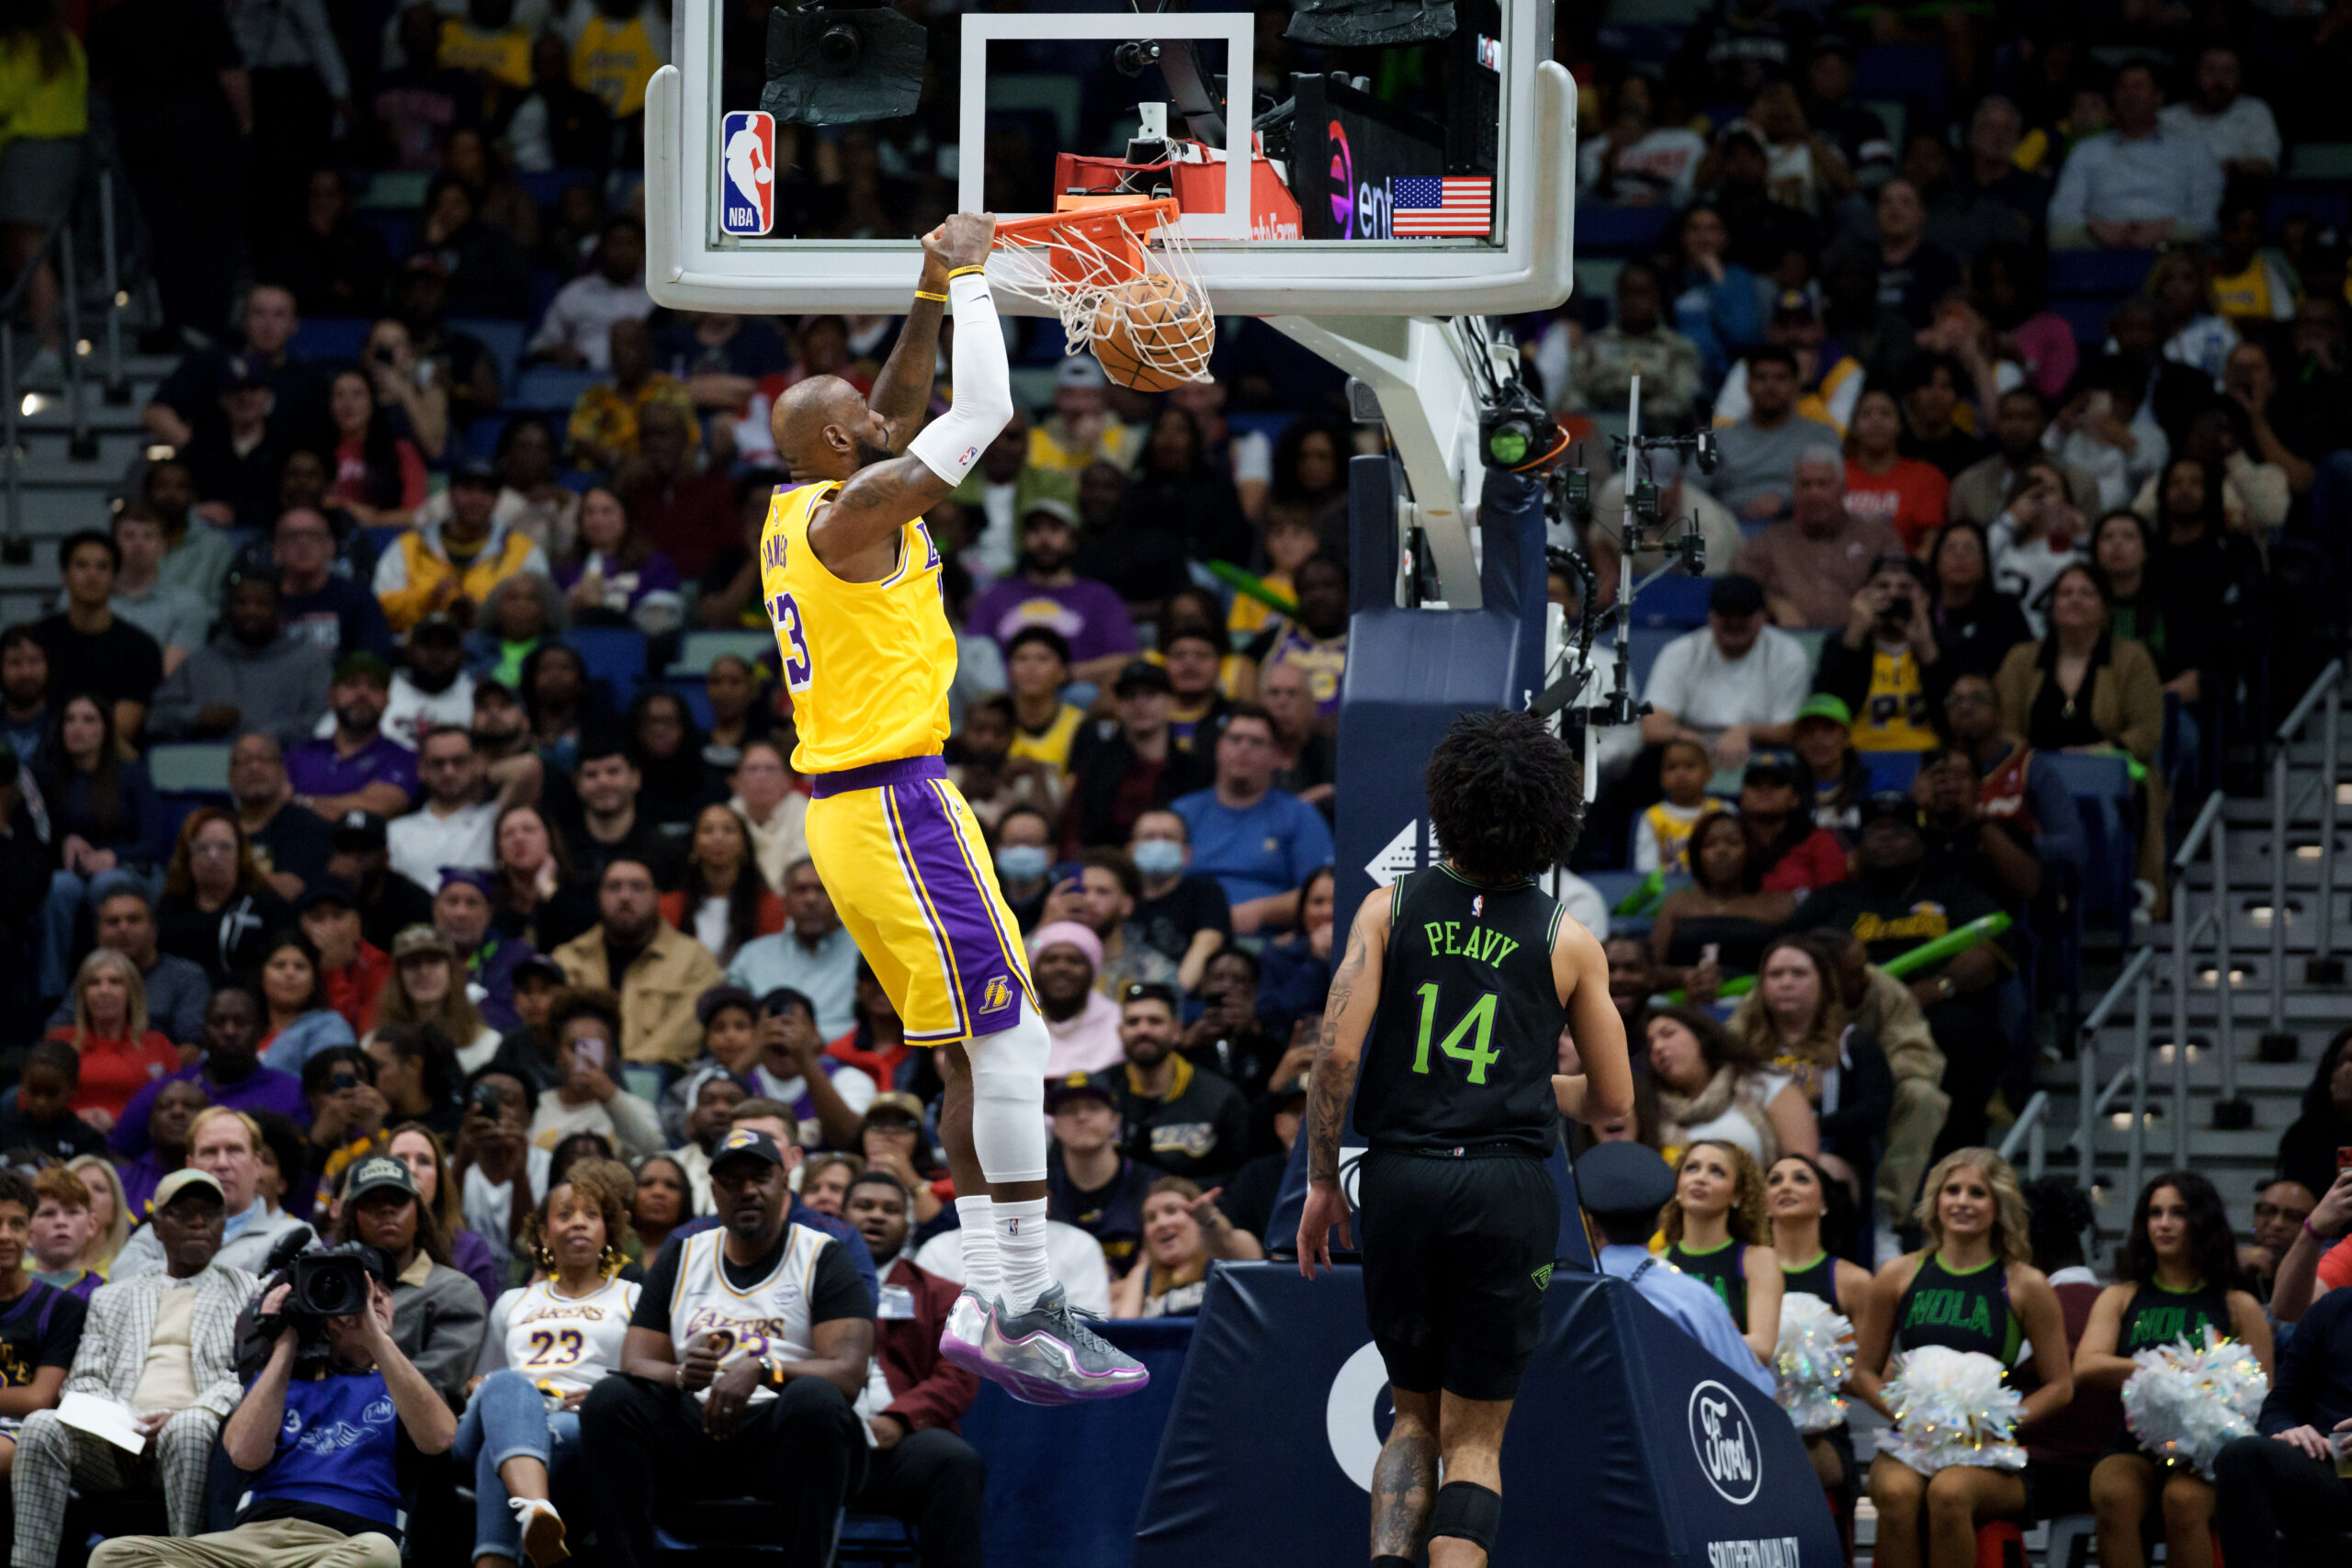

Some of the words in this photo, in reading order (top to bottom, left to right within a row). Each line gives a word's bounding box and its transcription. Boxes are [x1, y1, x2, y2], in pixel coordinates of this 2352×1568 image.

[729, 207, 753, 227] NBA
[763, 534, 787, 577] JAMES
[1424, 921, 1519, 968] PEAVY
[1410, 979, 1505, 1086] 14
[1904, 1289, 1992, 1338] NOLA
[526, 1328, 584, 1369] 23
[1701, 1396, 1752, 1482] Ford
